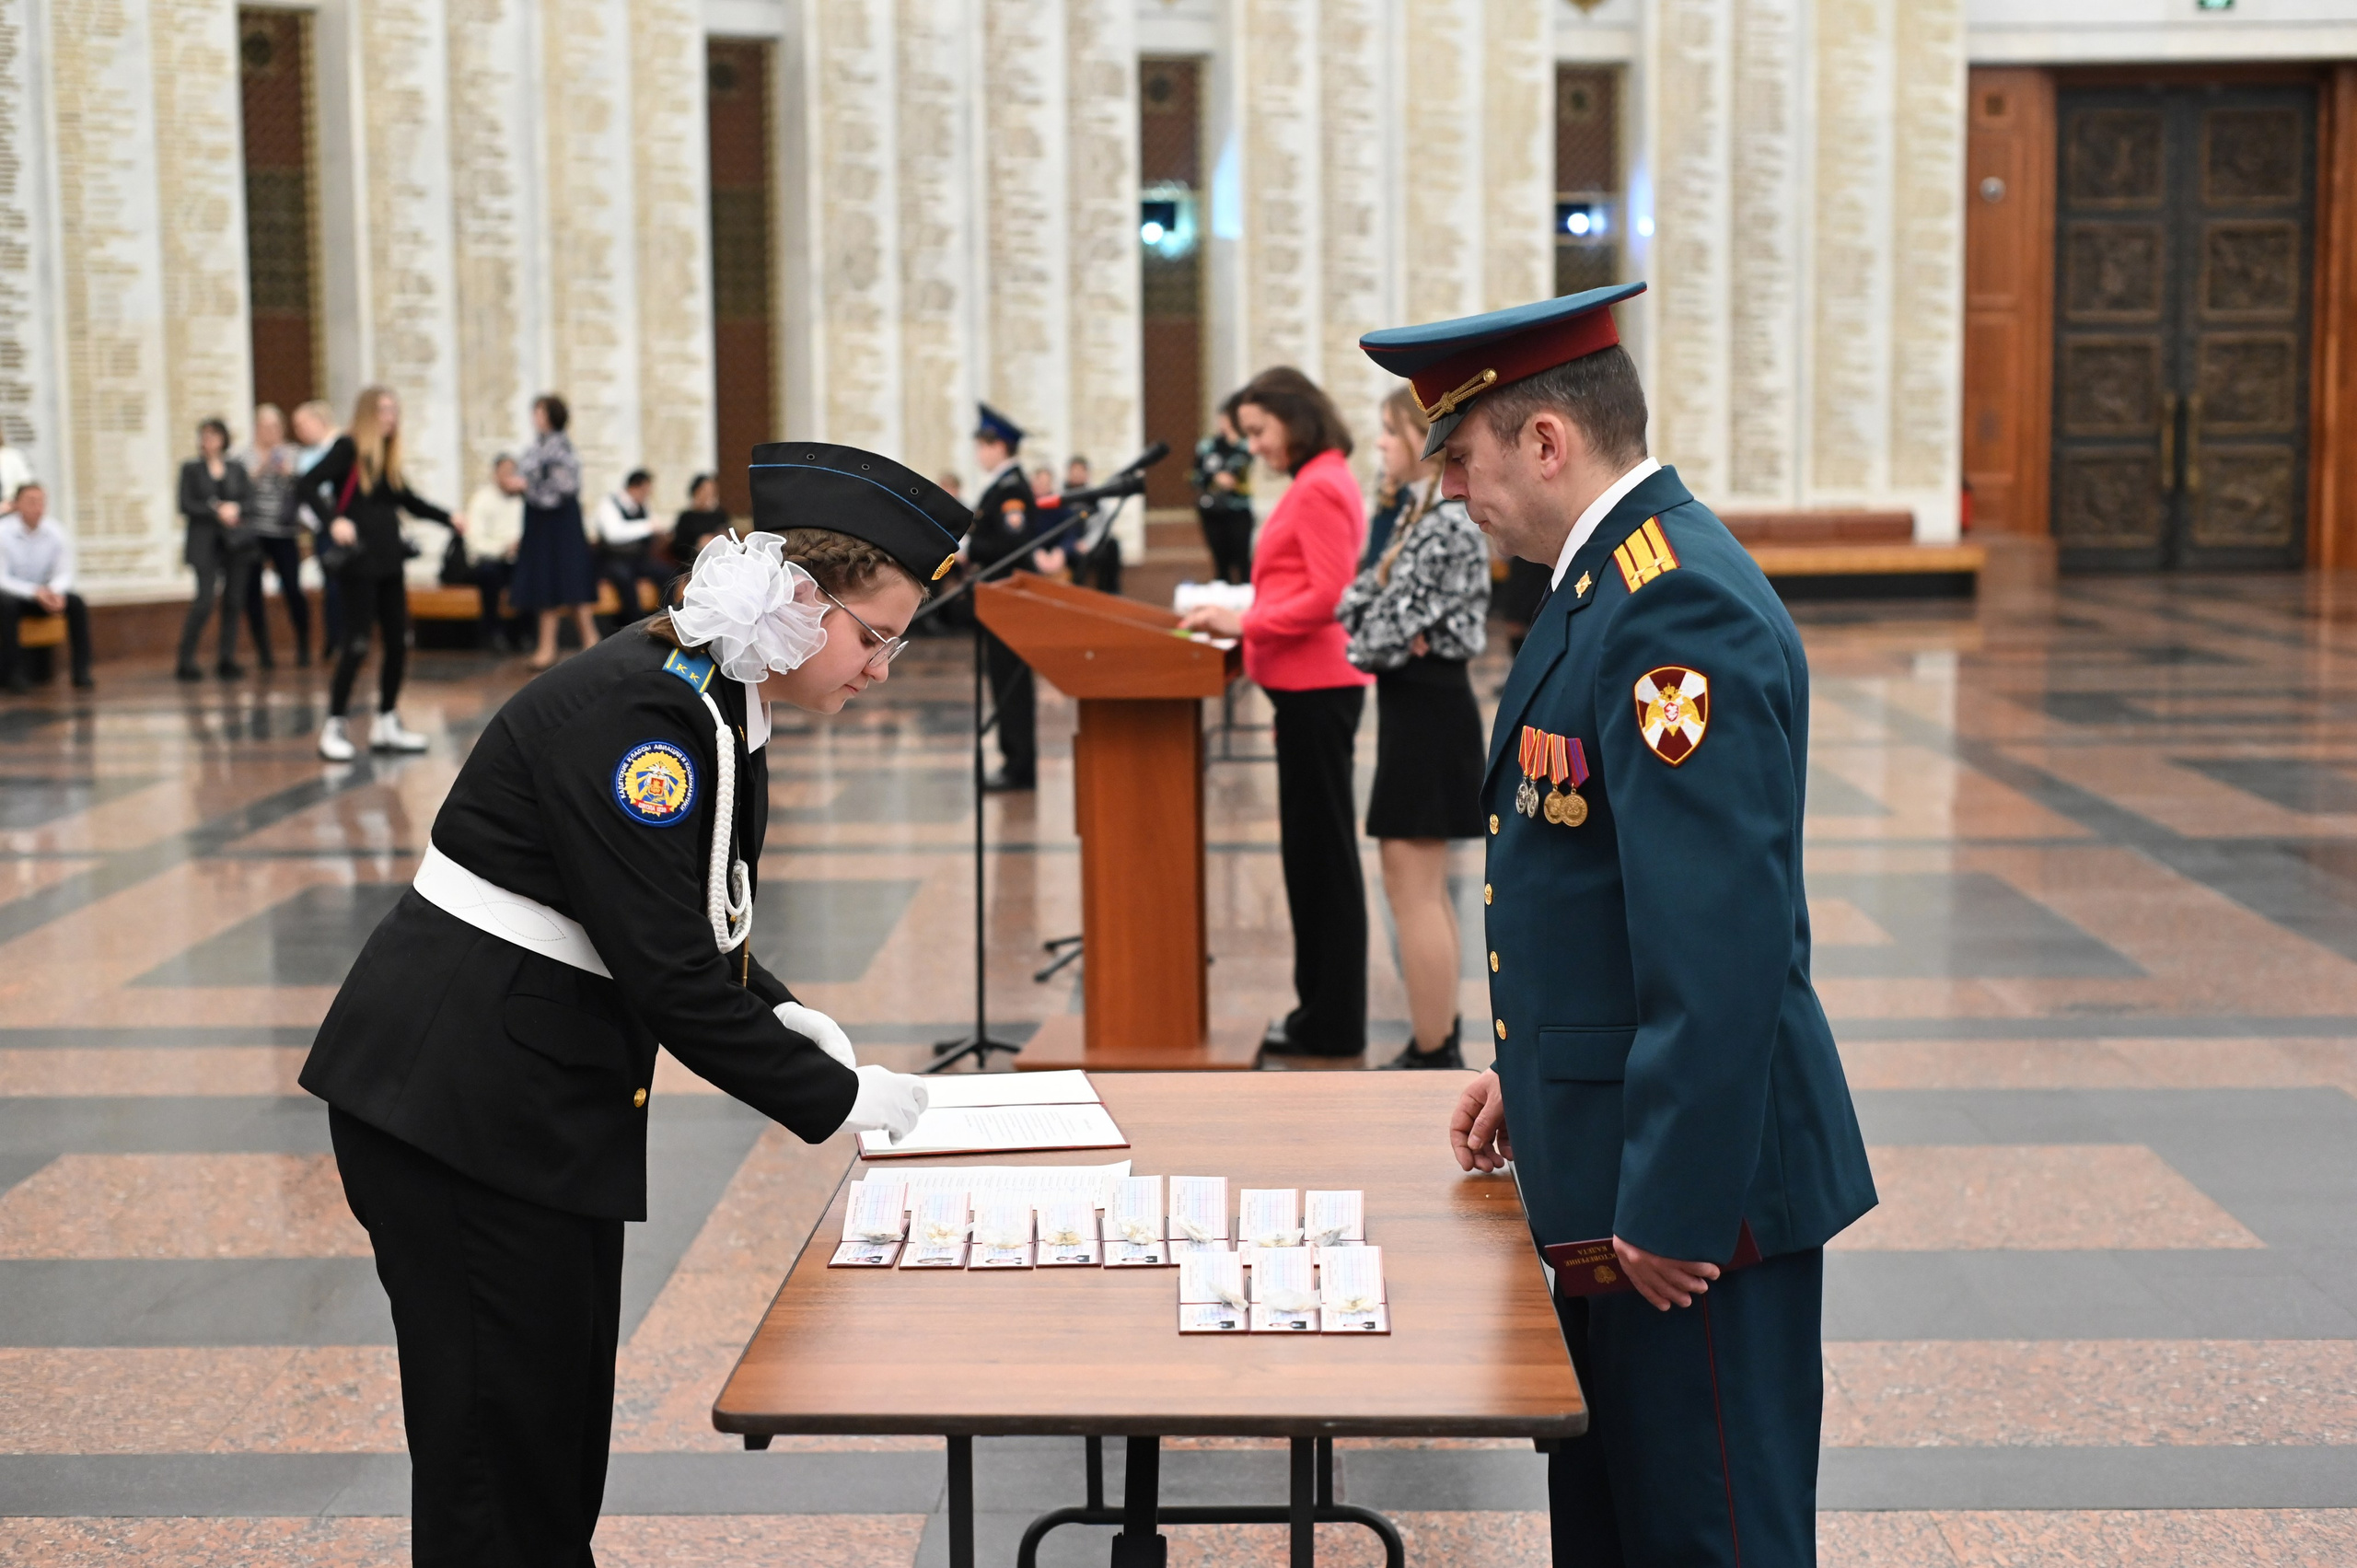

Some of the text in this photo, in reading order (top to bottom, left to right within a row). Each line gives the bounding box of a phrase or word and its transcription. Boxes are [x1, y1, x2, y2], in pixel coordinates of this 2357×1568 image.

[618, 762, 629, 799] КАДЕТСКИЕ
[627, 745, 651, 762] КЛАССЫ
[654, 744, 682, 759] АВИАЦИИ
[680, 762, 694, 811] КОСМОНАВТИКИ
[1577, 1246, 1608, 1255] КАДЕТА
[1564, 1253, 1618, 1266] ОСТОВЕРЕНИЕ
